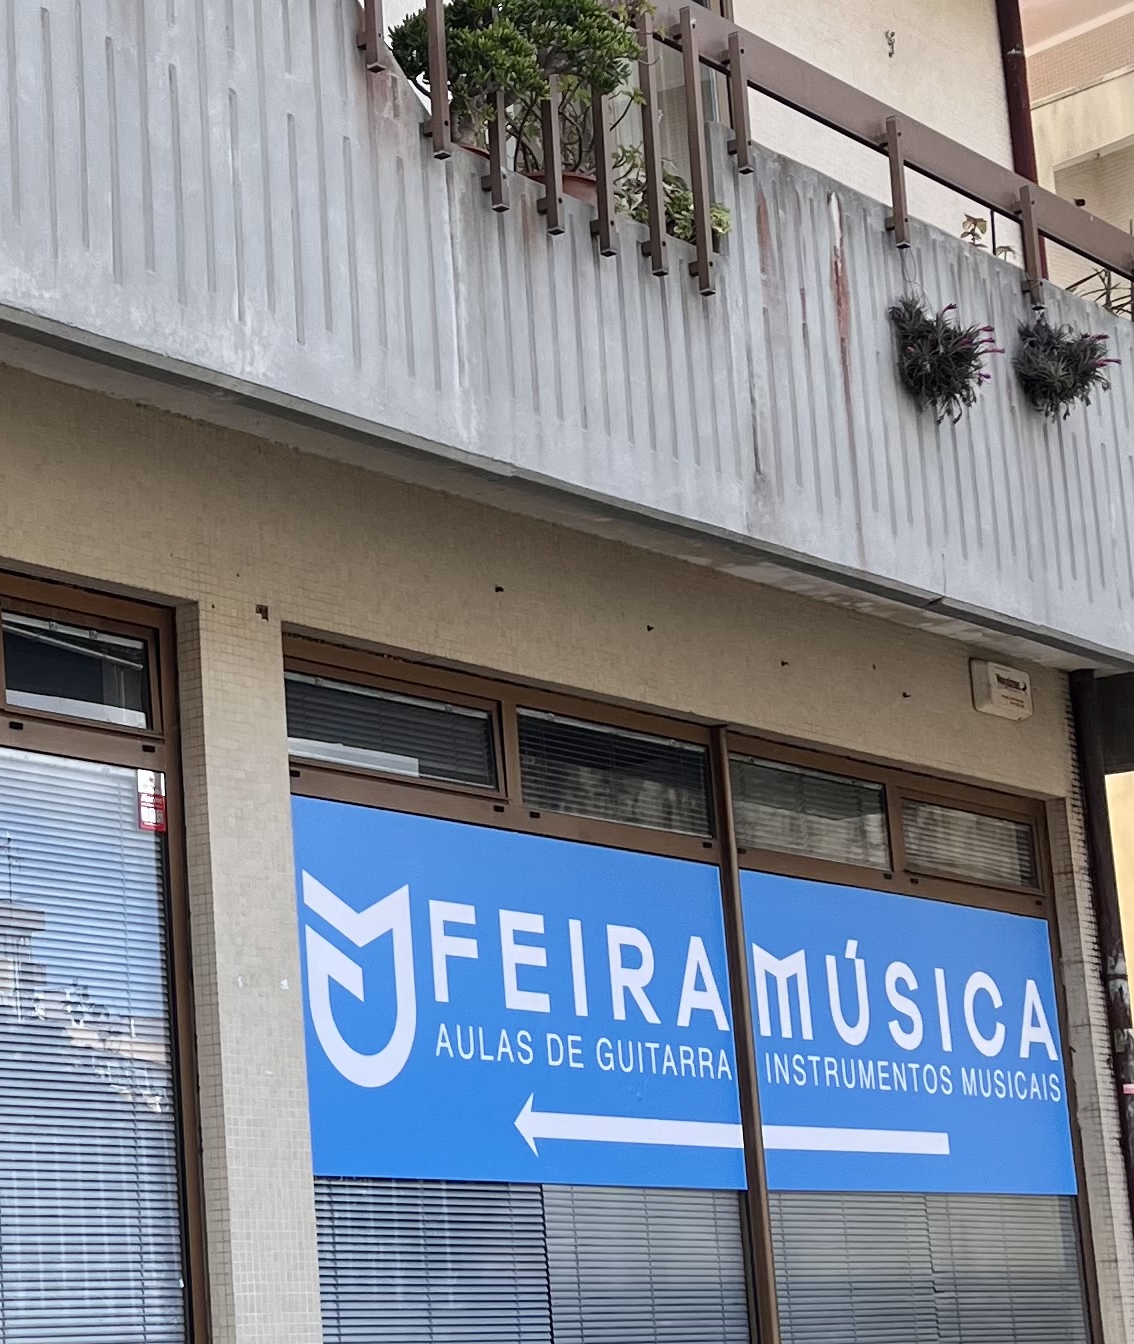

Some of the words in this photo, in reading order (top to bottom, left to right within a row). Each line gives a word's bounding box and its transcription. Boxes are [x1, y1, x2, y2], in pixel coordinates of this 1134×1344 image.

[429, 899, 730, 1032] FEIRA
[751, 939, 1058, 1060] MÚSICA
[434, 1023, 534, 1065] AULAS
[547, 1034, 583, 1069] DE
[596, 1037, 733, 1081] GUITARRA
[765, 1052, 953, 1096] INSTRUMENTOS
[962, 1066, 1061, 1103] MUSICAIS
